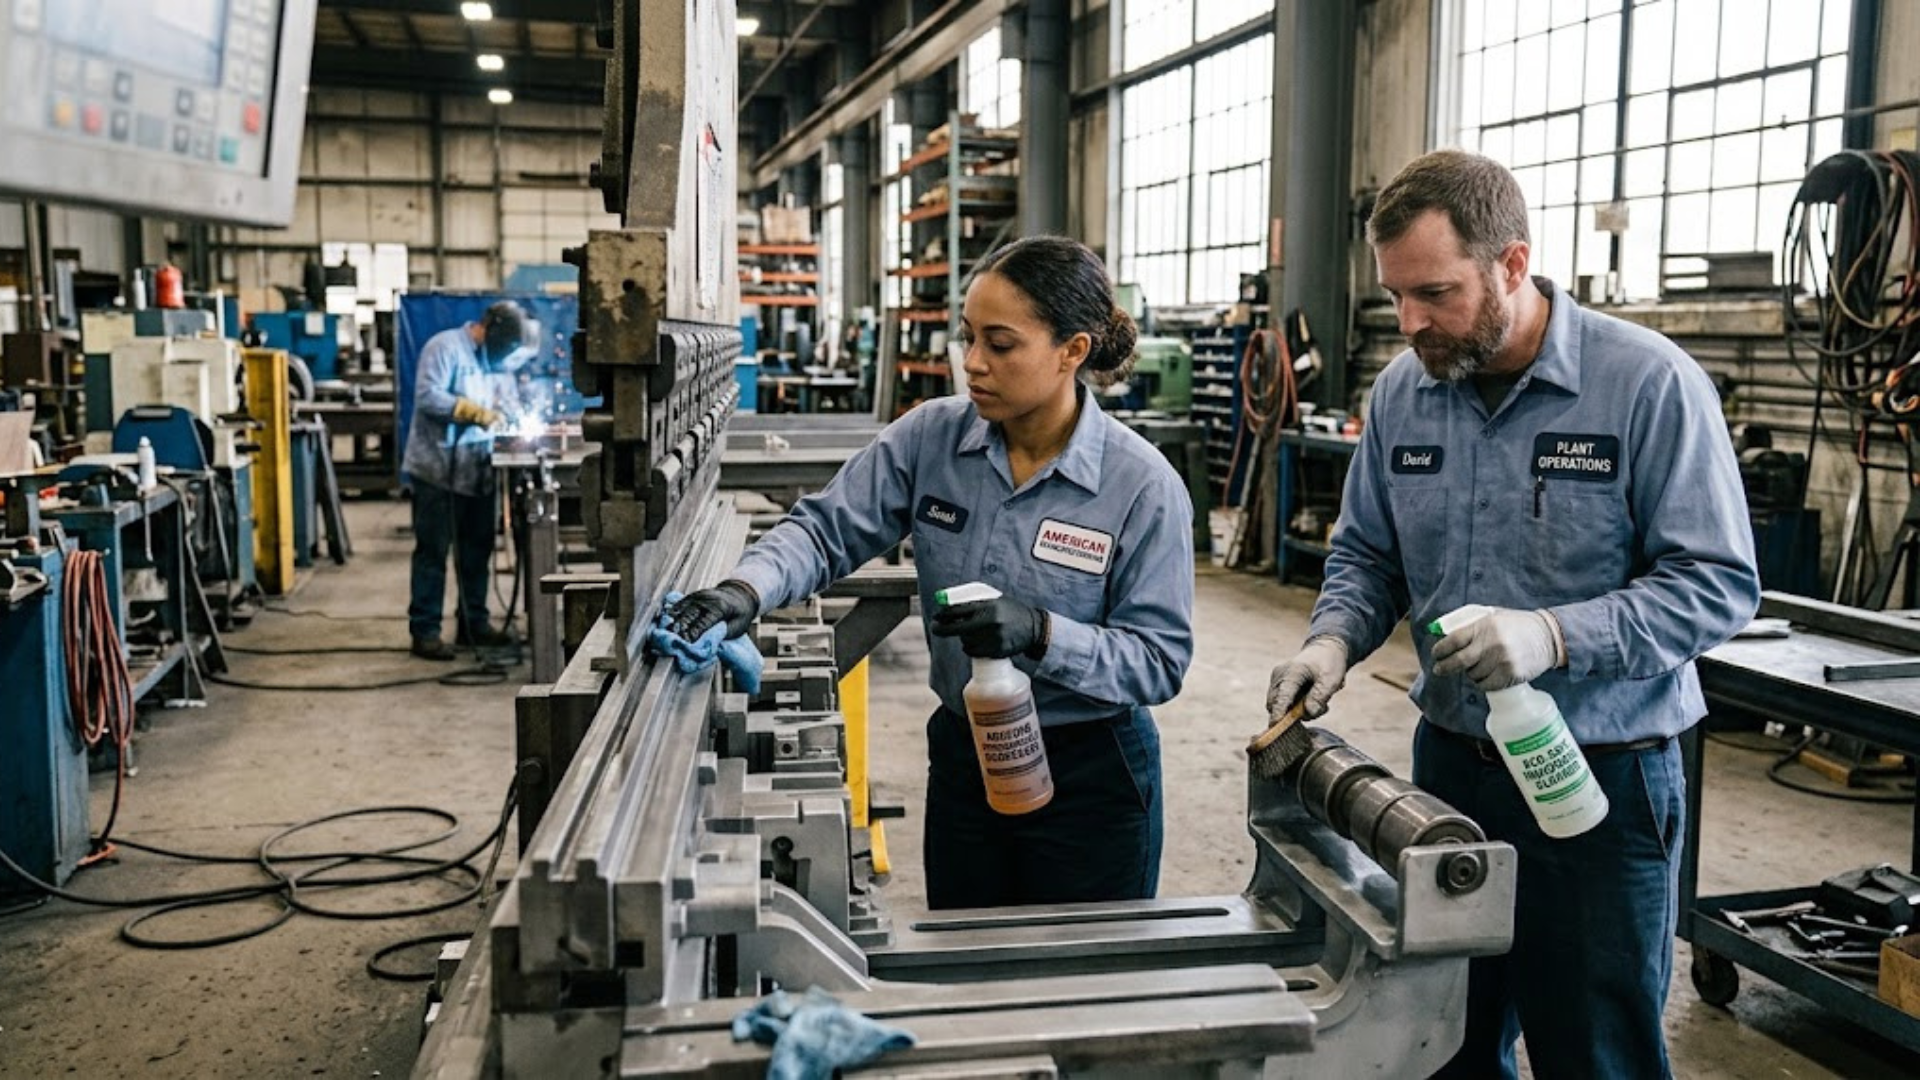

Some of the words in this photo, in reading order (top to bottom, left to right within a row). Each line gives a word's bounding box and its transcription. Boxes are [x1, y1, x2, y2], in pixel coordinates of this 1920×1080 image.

[1557, 441, 1595, 455] PLANT
[1538, 455, 1611, 473] OPERATIONS
[1042, 529, 1107, 554] AMERICAN
